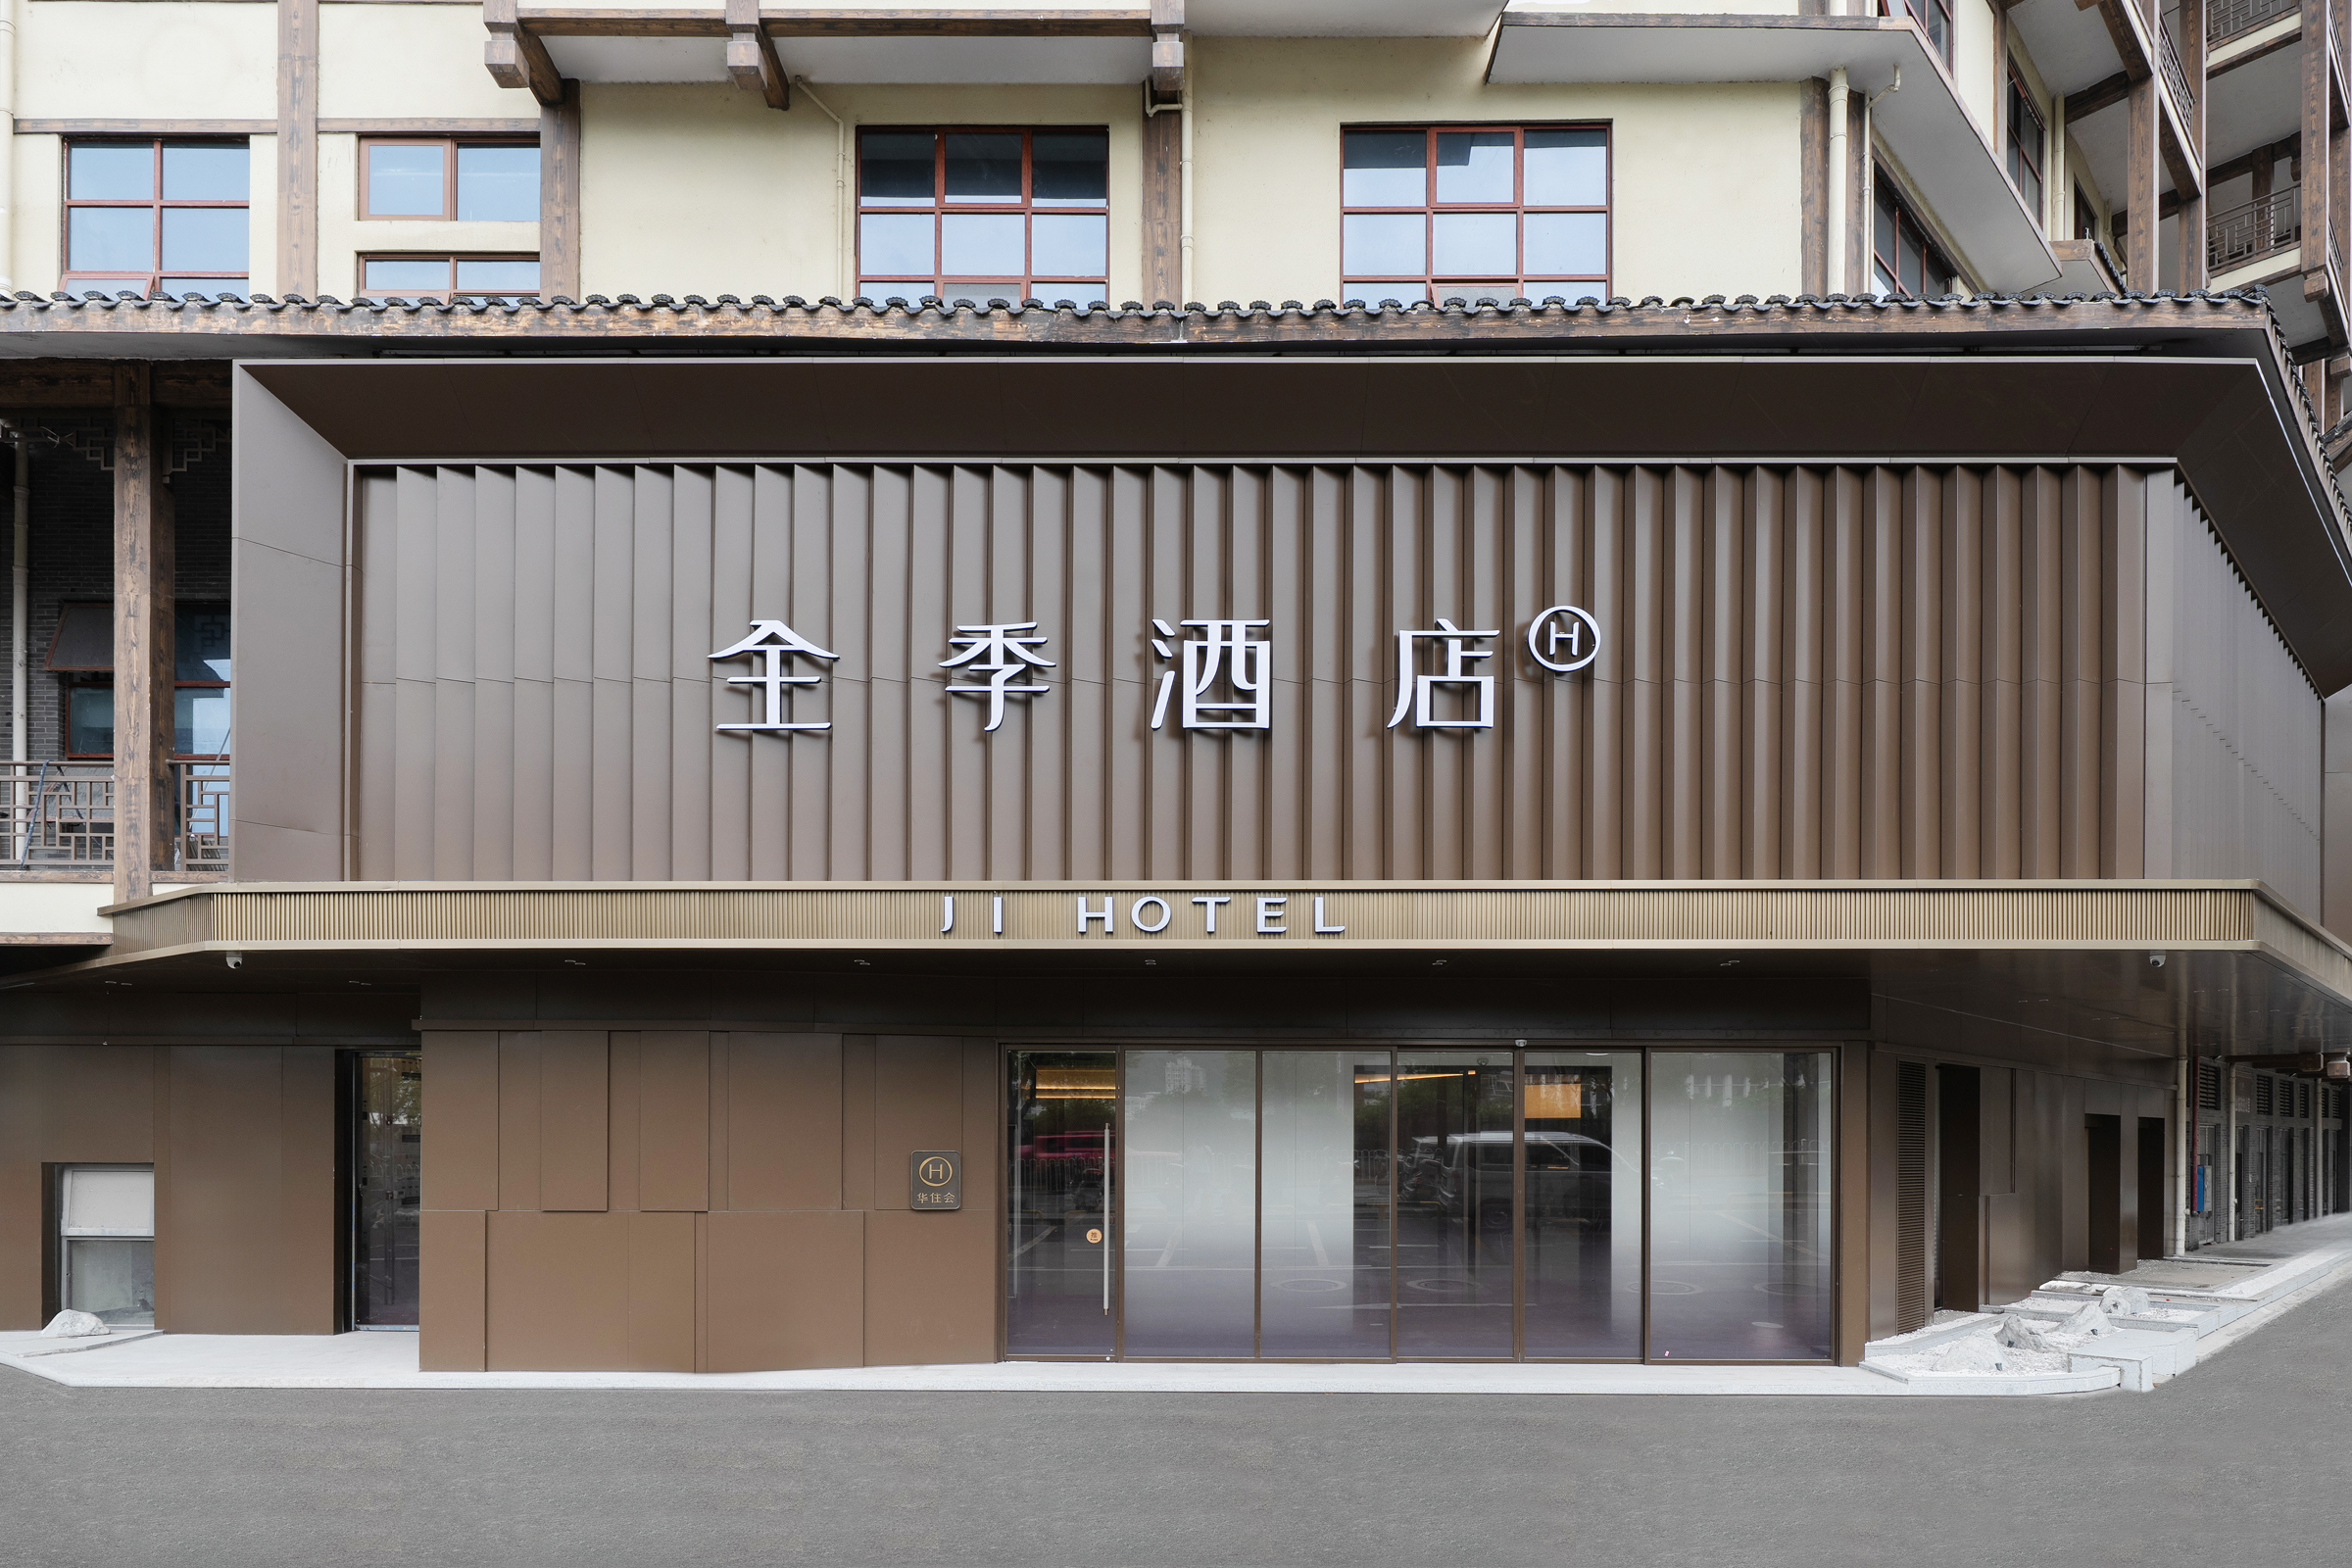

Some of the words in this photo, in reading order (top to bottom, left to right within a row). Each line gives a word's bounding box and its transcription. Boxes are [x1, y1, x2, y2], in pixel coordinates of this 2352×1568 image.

[707, 618, 1500, 730] 全季酒店
[940, 896, 1004, 934] JI
[1077, 896, 1347, 934] HOTEL
[917, 1192, 955, 1204] 华住会
